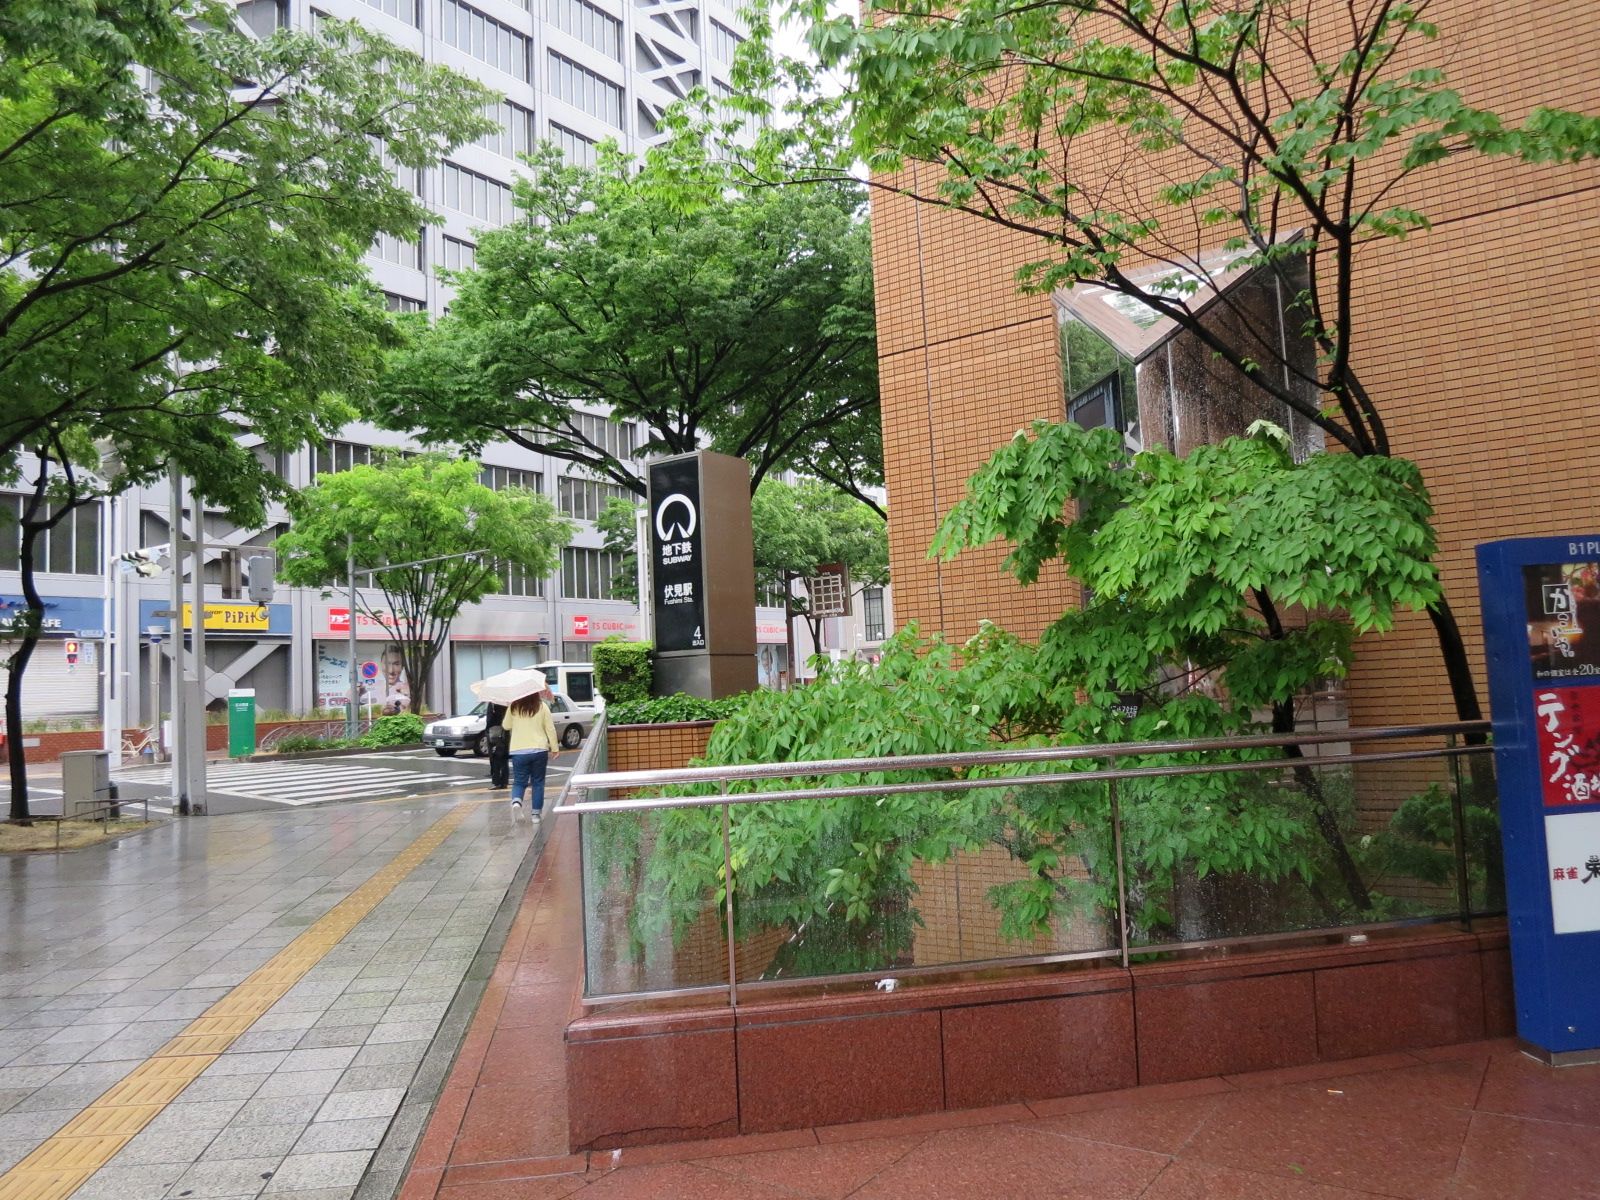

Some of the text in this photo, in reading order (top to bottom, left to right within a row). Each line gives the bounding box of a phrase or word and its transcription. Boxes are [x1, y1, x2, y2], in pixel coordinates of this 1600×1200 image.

[662, 541, 692, 556] 地下鉄
[662, 554, 692, 565] SUBWAY
[664, 582, 693, 598] 伏見駅
[664, 597, 682, 605] Fushimi
[602, 622, 625, 630] CUBIC
[693, 625, 702, 639] 4
[1537, 693, 1580, 783] テング
[1553, 867, 1578, 880] 麻雀
